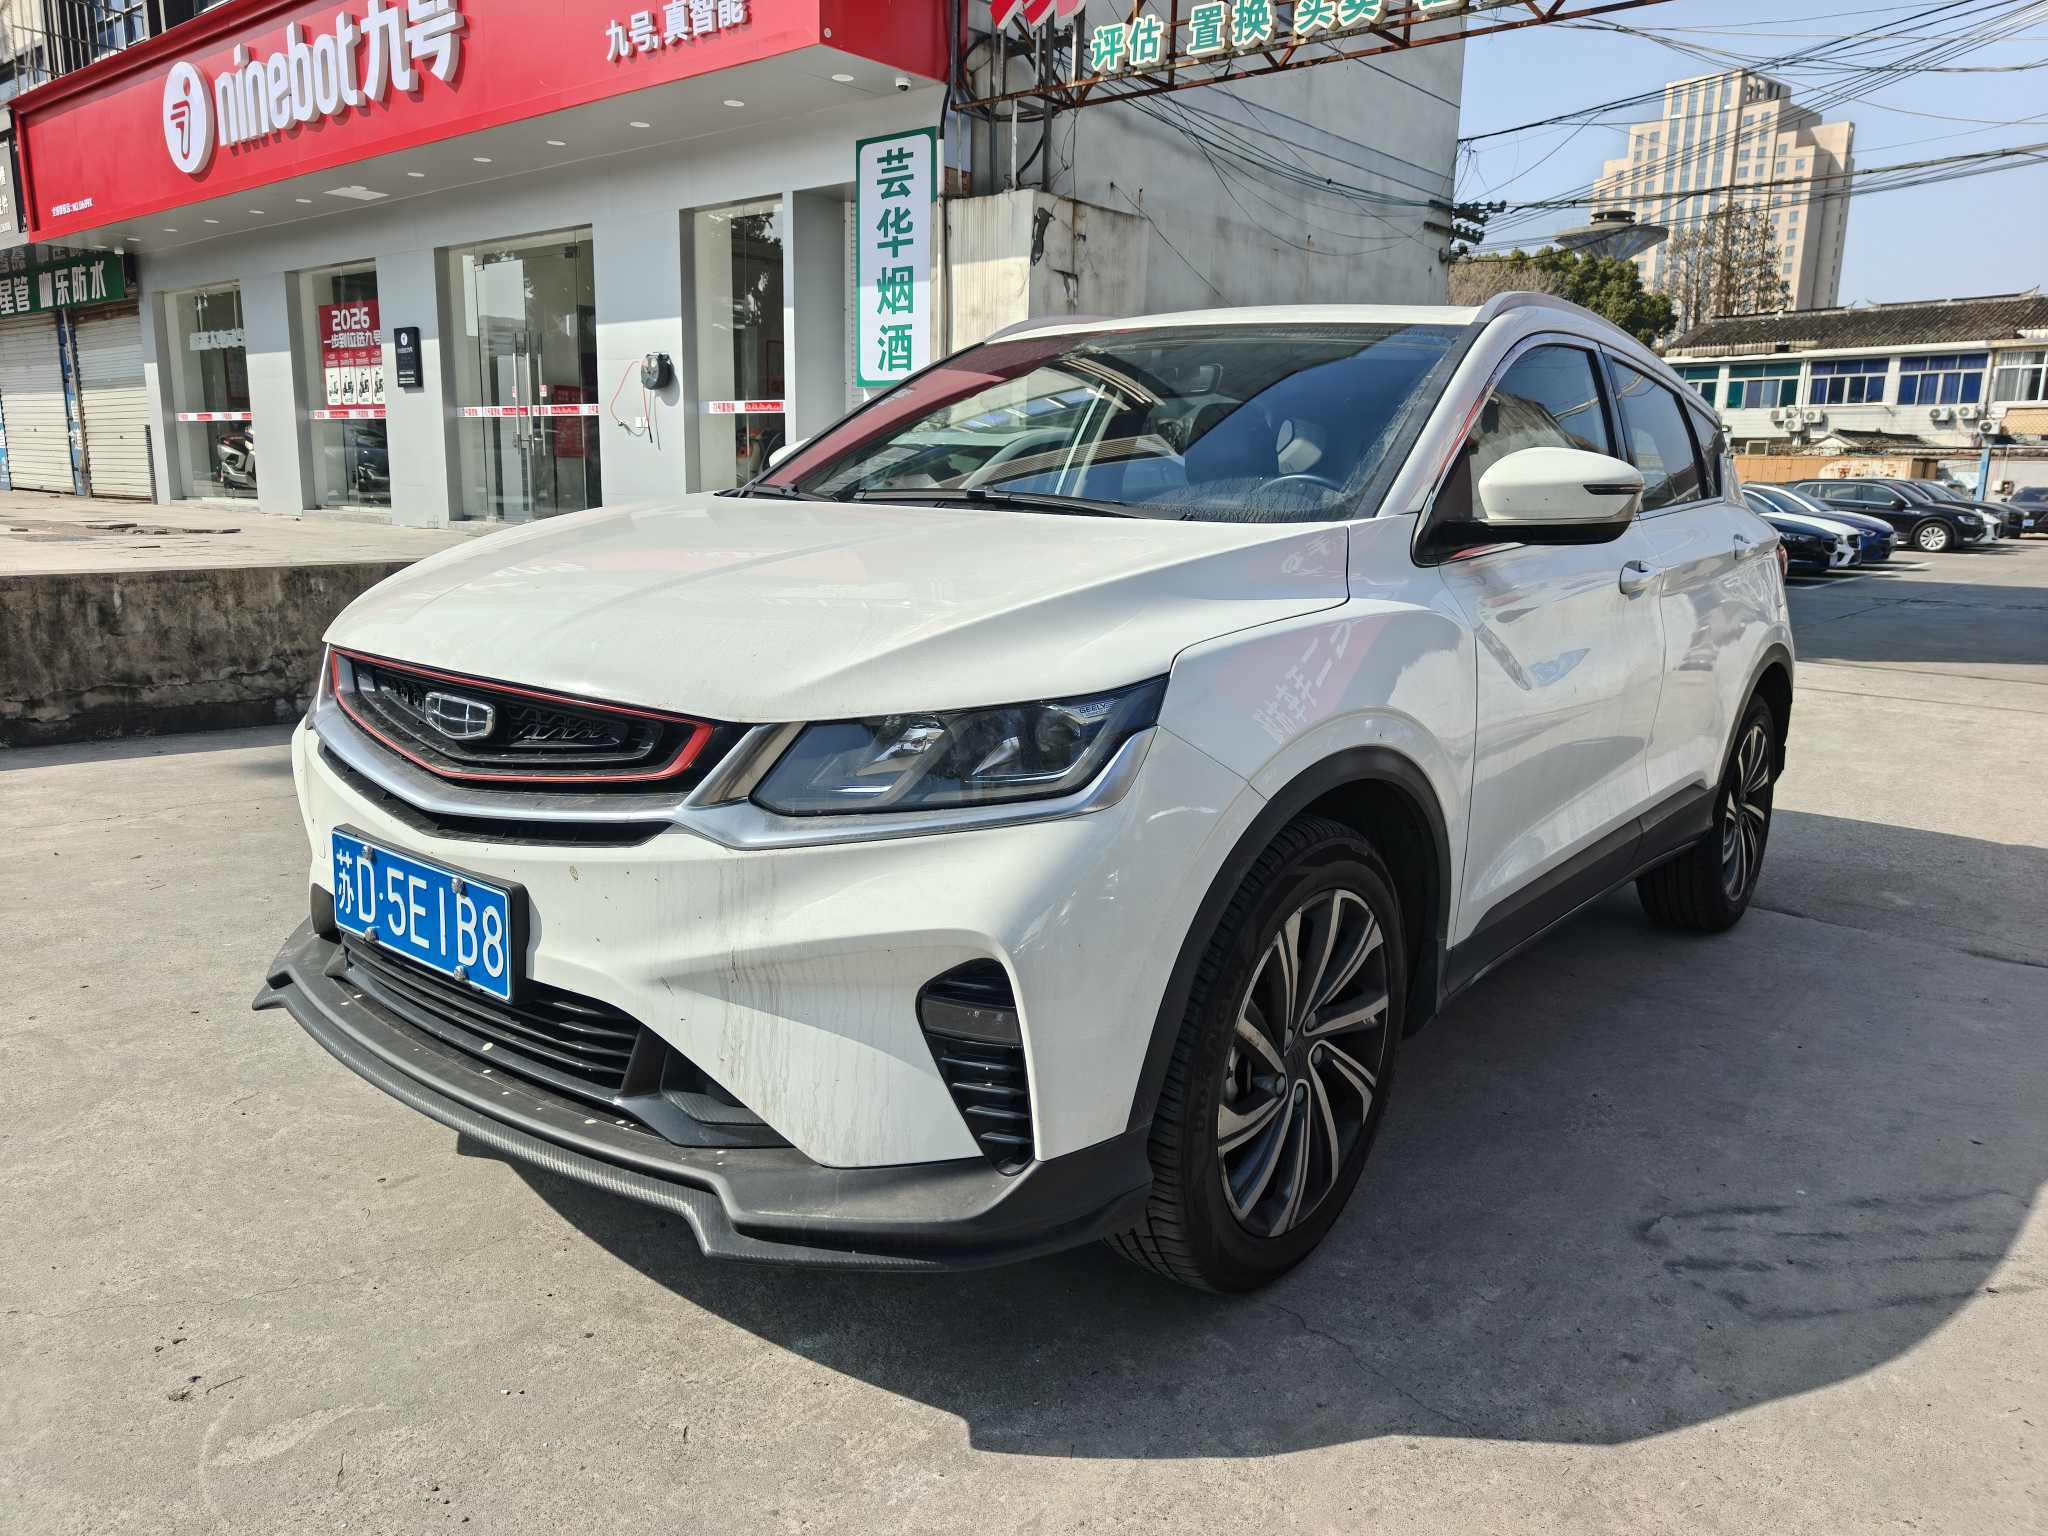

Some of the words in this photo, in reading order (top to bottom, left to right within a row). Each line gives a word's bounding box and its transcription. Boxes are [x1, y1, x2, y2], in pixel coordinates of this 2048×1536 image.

[1092, 16, 1163, 70] 评估
[1188, 1, 1272, 53] 置换
[875, 146, 915, 372] 芸华烟酒
[331, 306, 370, 332] 2026
[1080, 702, 1107, 714] GEELY
[336, 848, 504, 978] 苏D·5E1B8
